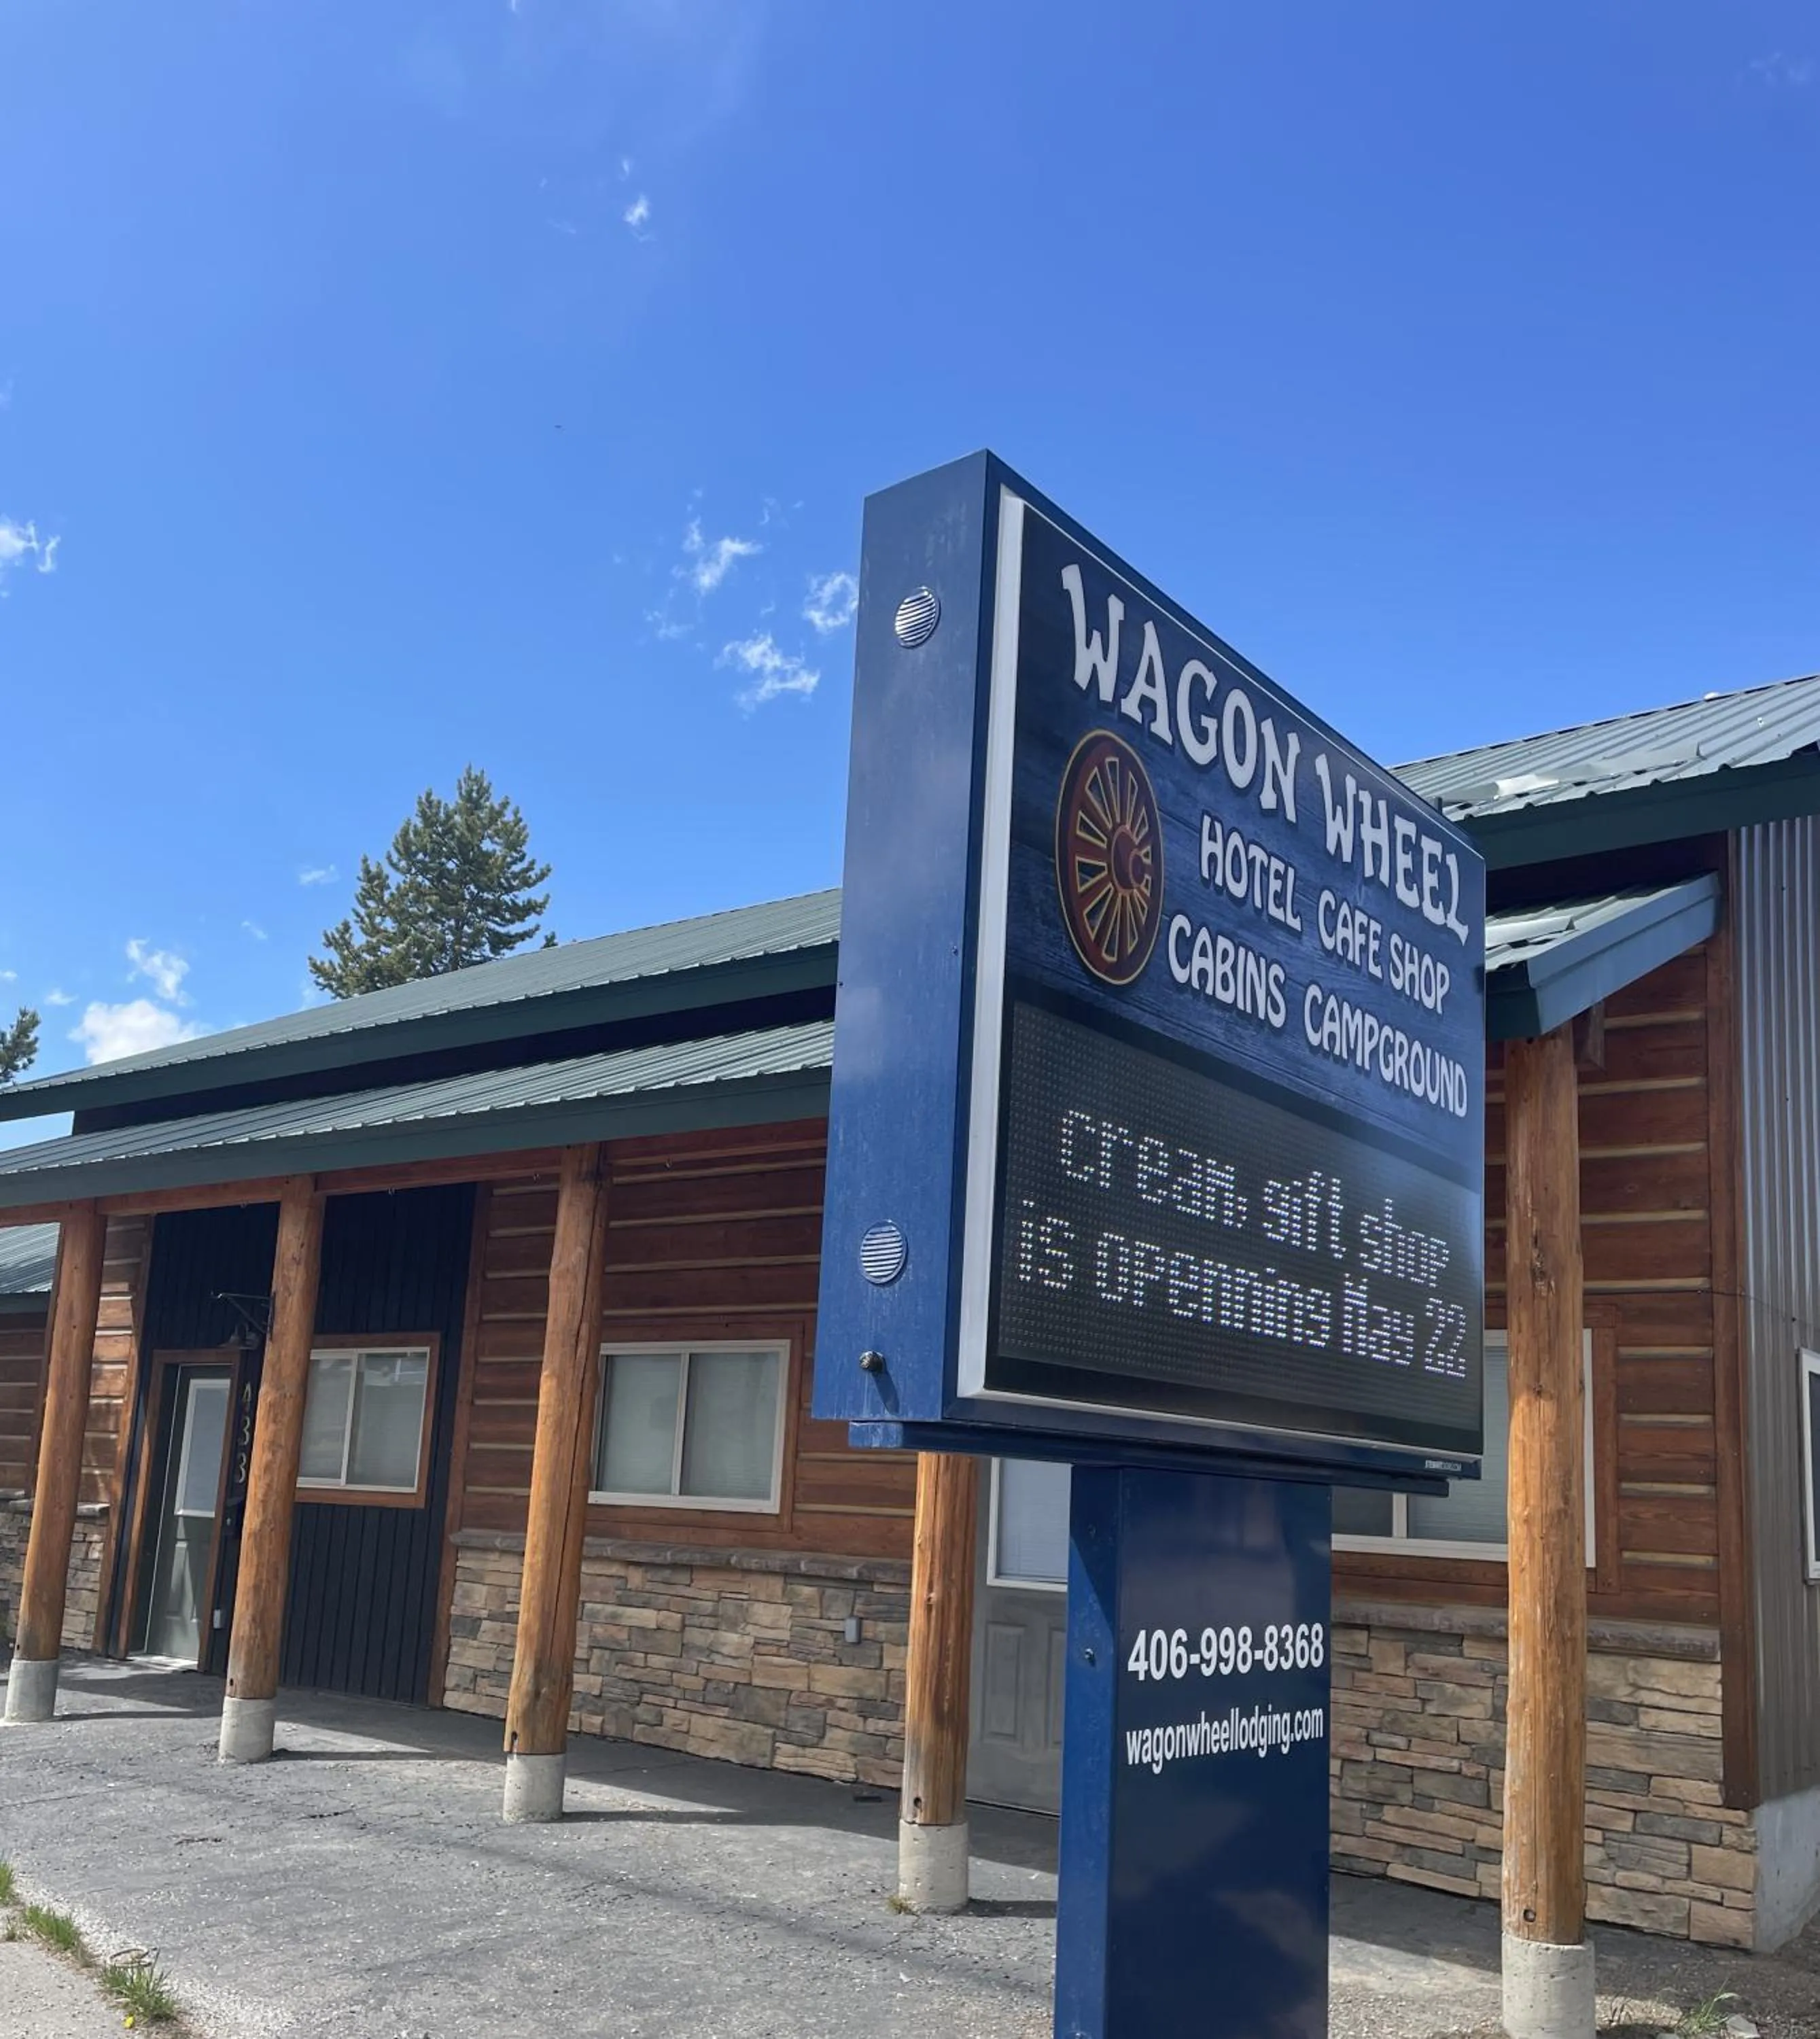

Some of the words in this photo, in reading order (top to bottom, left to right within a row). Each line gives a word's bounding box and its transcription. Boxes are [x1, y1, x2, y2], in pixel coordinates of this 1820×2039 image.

[1062, 564, 1301, 823] WAGON
[1315, 754, 1469, 945] WHEEL
[1201, 815, 1302, 931] HOTEL
[1318, 890, 1383, 979] CAFE
[1390, 933, 1450, 1014] SHOP
[1168, 914, 1287, 1028] CABINS
[1304, 984, 1467, 1117] CAMPGROUND
[1019, 1199, 1076, 1290] is
[1343, 1272, 1414, 1365] May
[1425, 1297, 1466, 1378] 22
[1262, 1170, 1346, 1259] gift
[1360, 1198, 1450, 1288] shop
[236, 1382, 251, 1484] 433
[1127, 1622, 1324, 1681] 406-998-8368
[1126, 1704, 1324, 1774] wagonwheellodging.com
